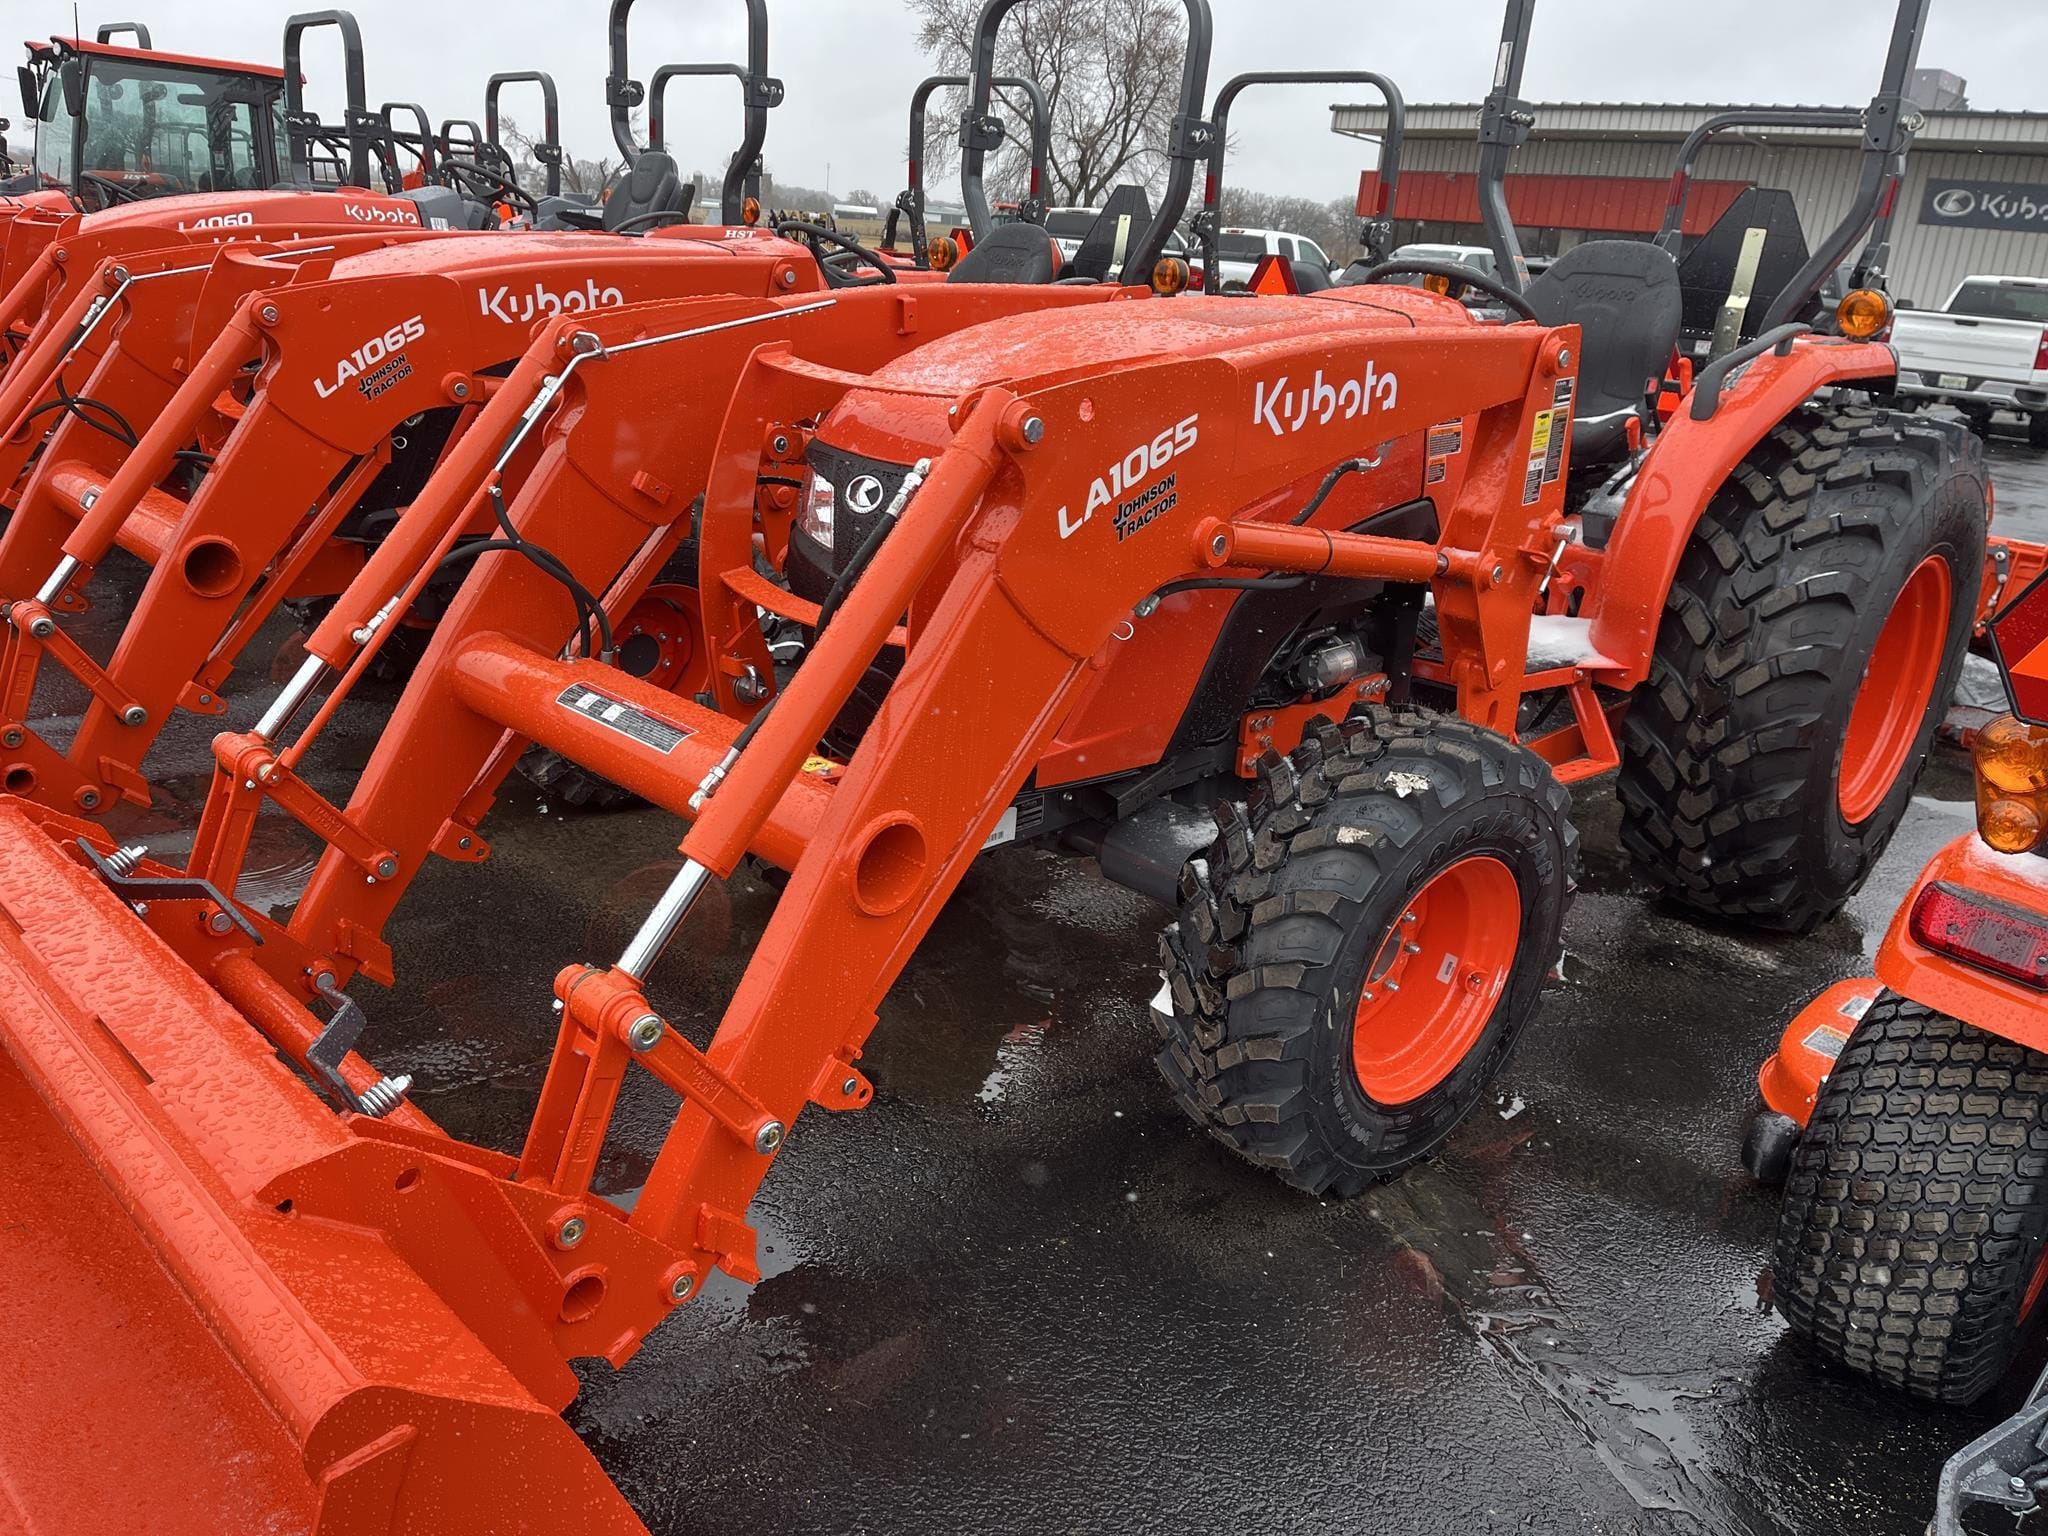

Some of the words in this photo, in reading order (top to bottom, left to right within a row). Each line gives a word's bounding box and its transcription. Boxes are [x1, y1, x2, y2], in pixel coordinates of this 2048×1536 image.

[344, 203, 417, 225] Kubota
[724, 229, 757, 239] HST
[478, 278, 624, 324] Kubota
[313, 314, 426, 399] LA1065
[357, 353, 407, 393] JOHNSON
[362, 364, 413, 402] TRACTOR
[1253, 360, 1398, 437] Kubota
[1057, 412, 1199, 540] LA1065
[1112, 472, 1177, 526] JOHNSON
[1115, 491, 1178, 544] TRACTOR
